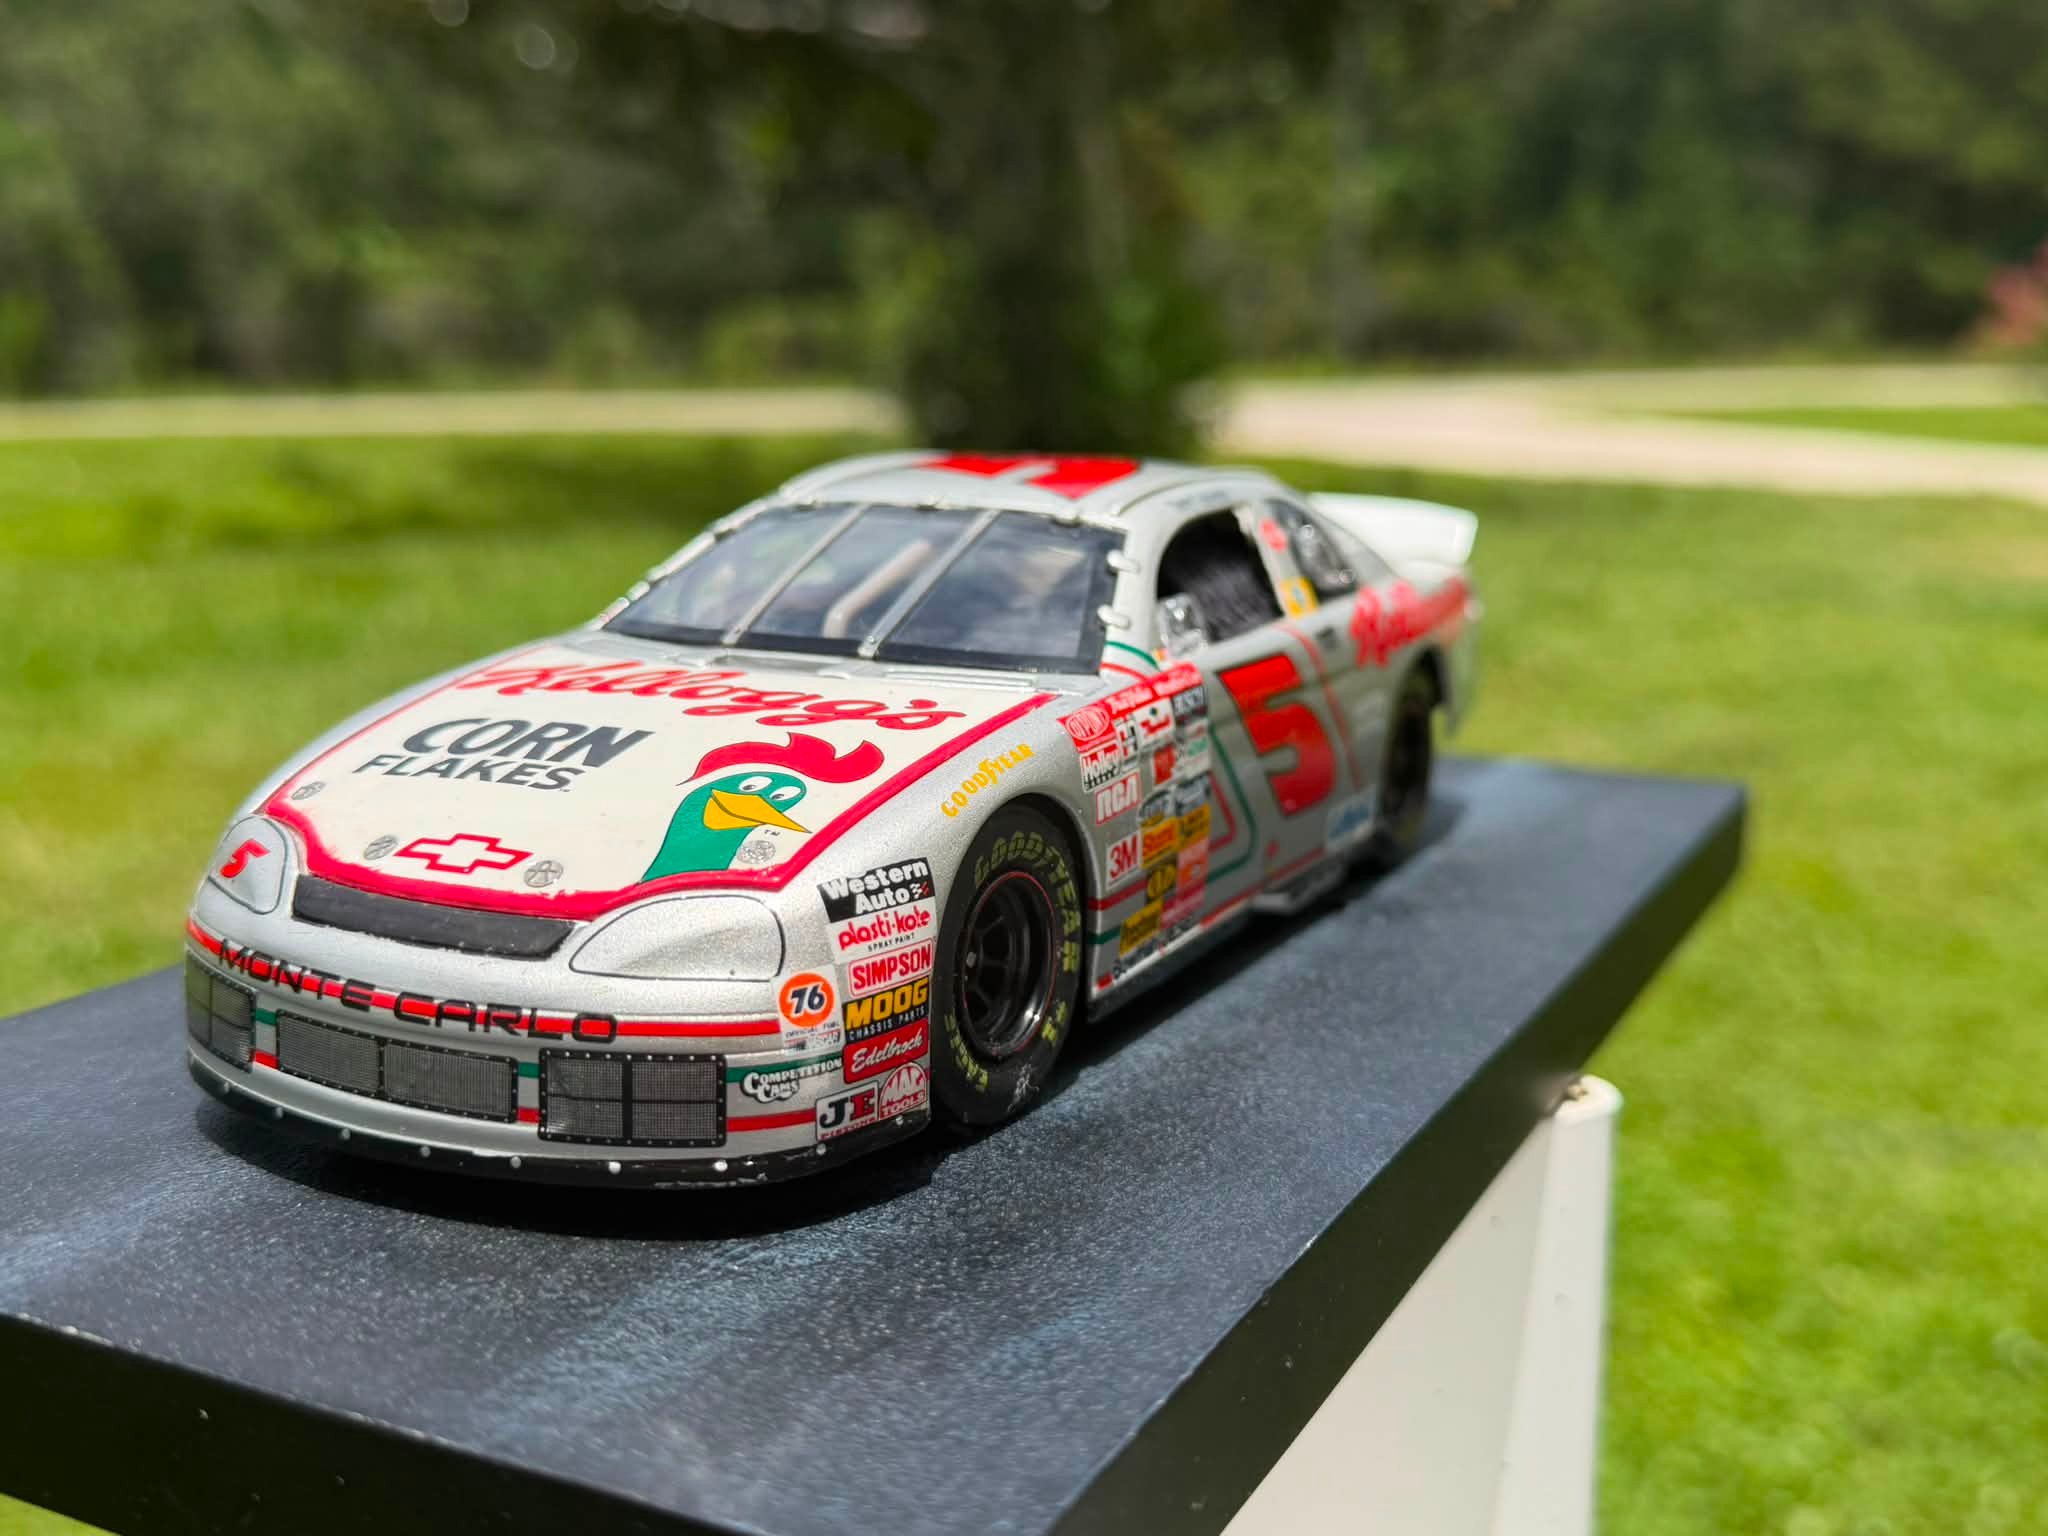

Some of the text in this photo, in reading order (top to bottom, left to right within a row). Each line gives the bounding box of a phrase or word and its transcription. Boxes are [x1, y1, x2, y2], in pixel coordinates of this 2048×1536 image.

[456, 660, 967, 731] Kellogg's
[403, 717, 656, 769] CORN
[1219, 654, 1337, 817] 5
[352, 754, 587, 791] FLAKES
[941, 743, 1035, 817] GOODYEAR
[1097, 772, 1139, 822] RCA
[218, 838, 270, 878] 5
[1110, 834, 1139, 879] 3M
[821, 860, 929, 900] Western
[855, 887, 910, 915] Auto
[852, 943, 931, 990] SIMPSON
[867, 939, 893, 952] SPRAY
[219, 937, 618, 1043] MONTE CARLO
[790, 984, 825, 1015] 76
[846, 977, 928, 1031] MOOG
[849, 1005, 925, 1039] CHASSIS PARTS
[851, 1027, 923, 1073] Edelbrock
[819, 1086, 875, 1129] JE
[881, 1066, 926, 1106] MAC
[881, 1092, 926, 1116] TOOLS
